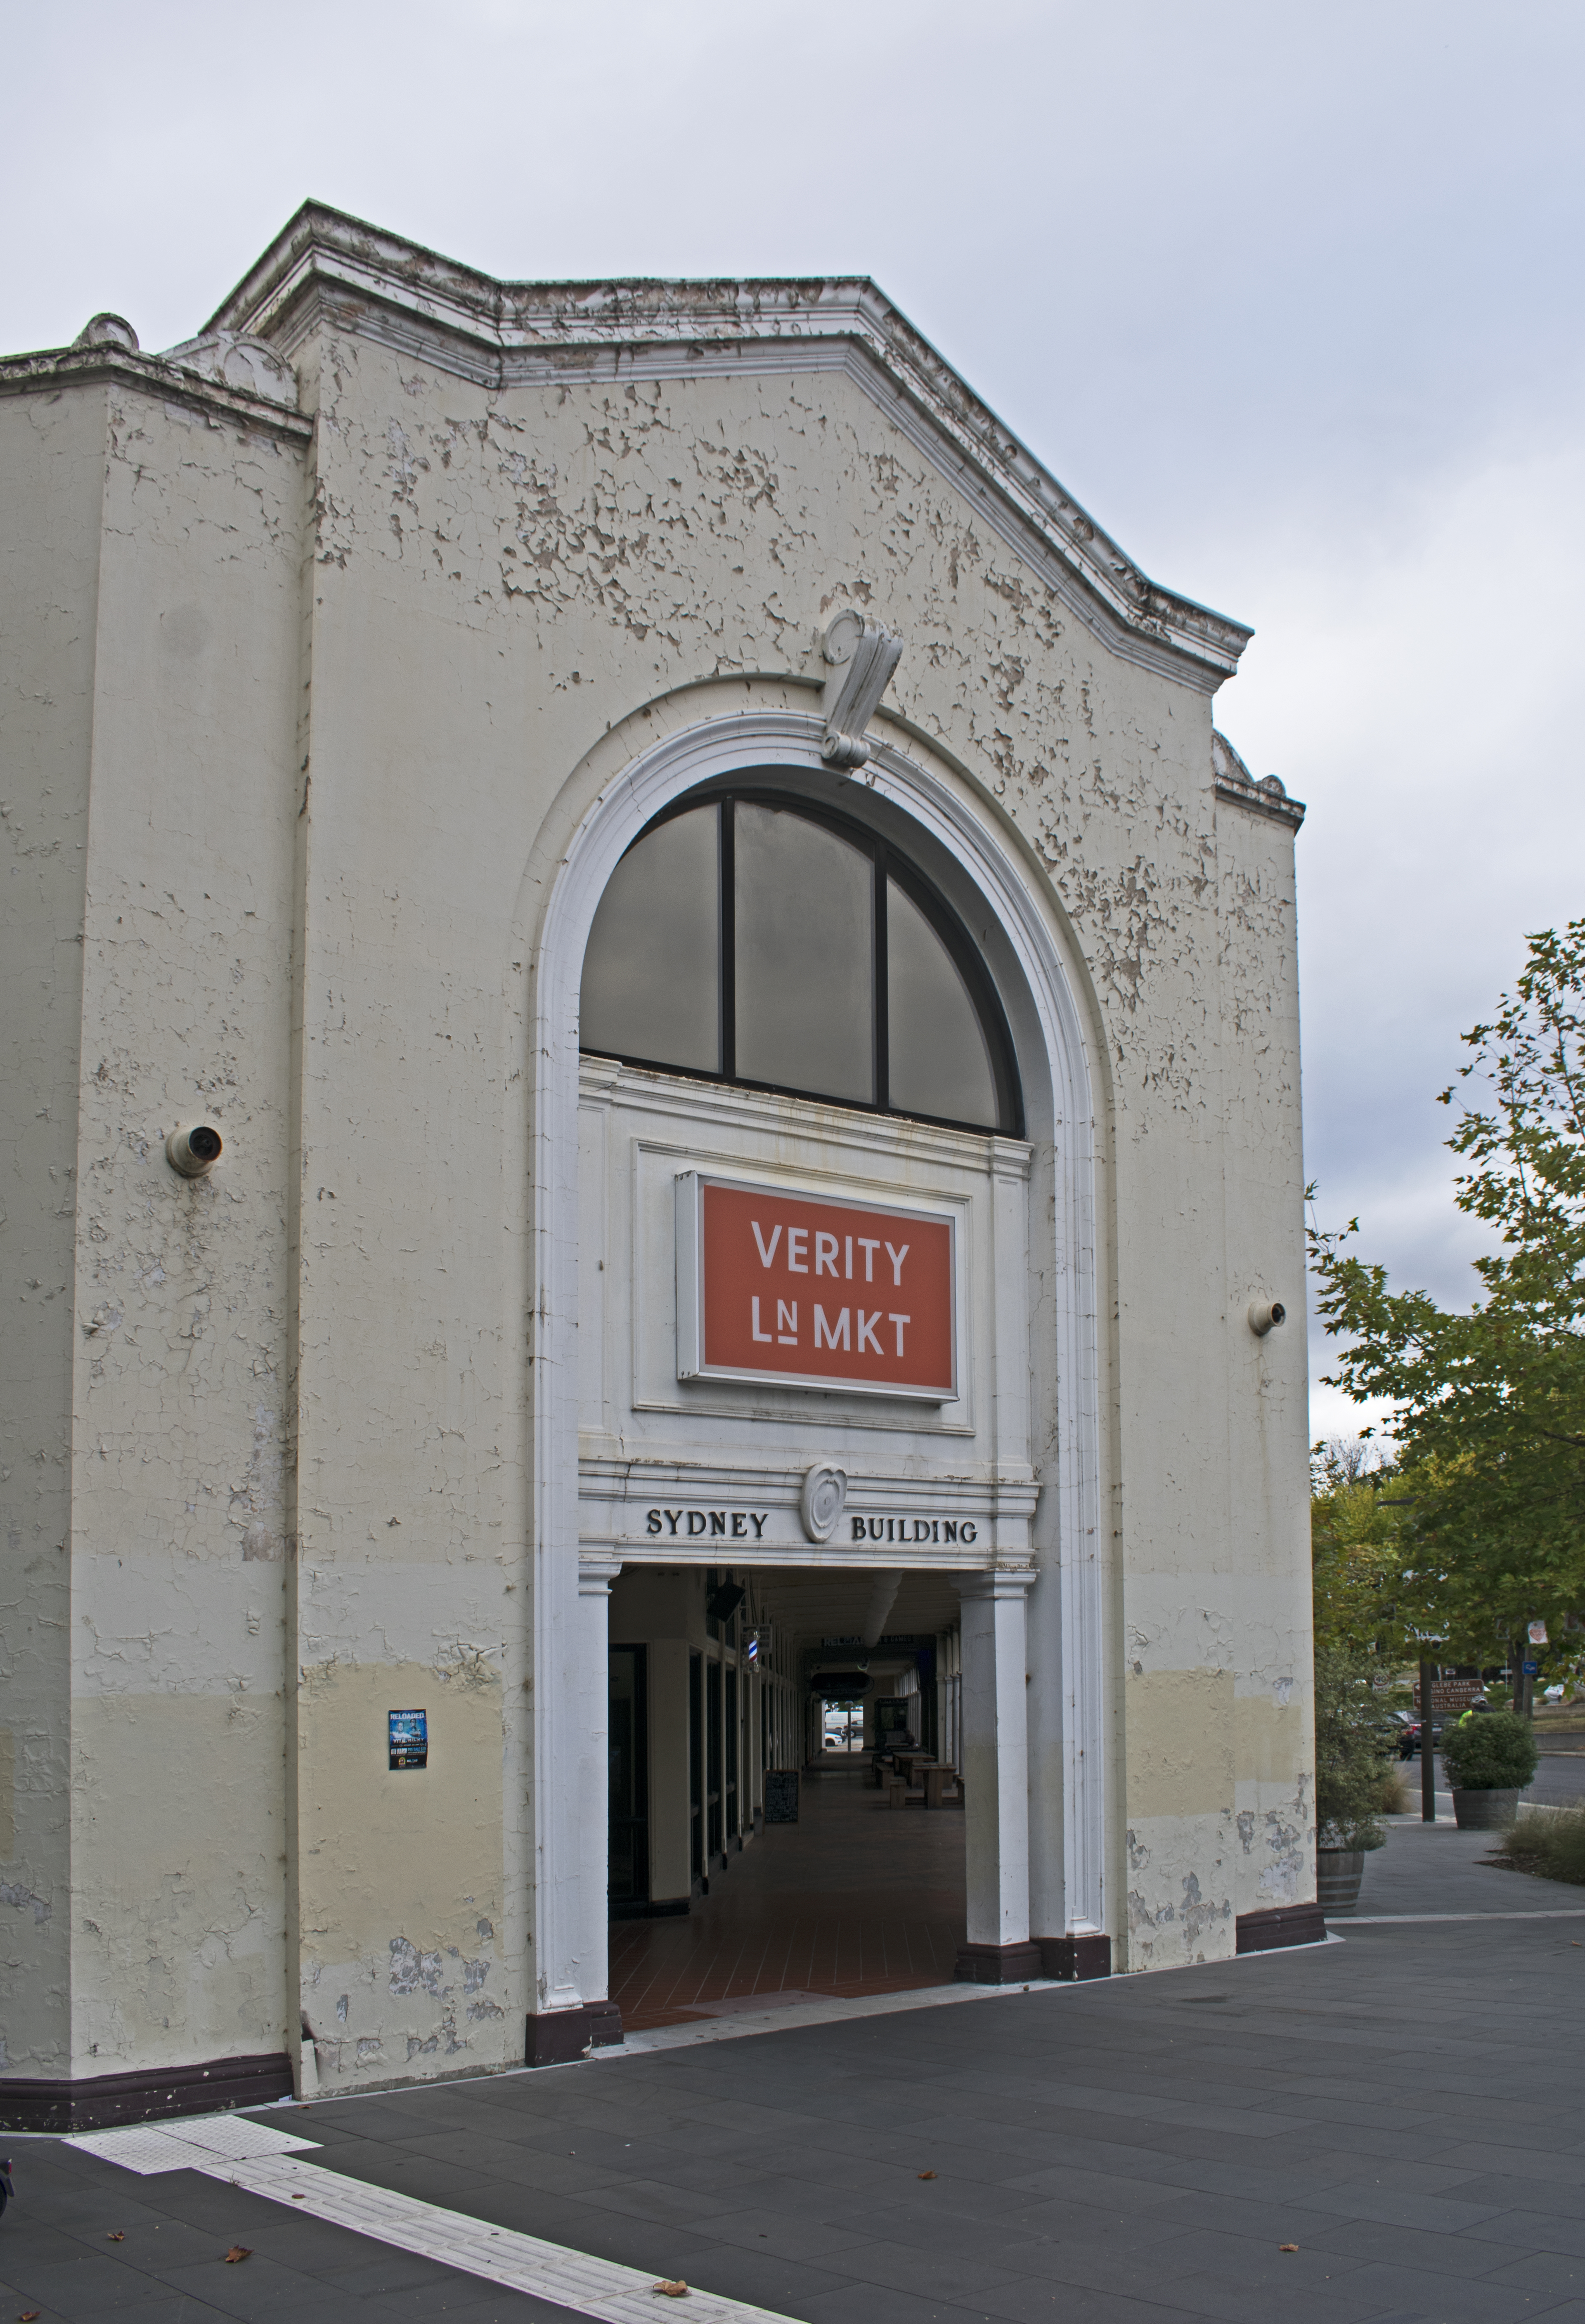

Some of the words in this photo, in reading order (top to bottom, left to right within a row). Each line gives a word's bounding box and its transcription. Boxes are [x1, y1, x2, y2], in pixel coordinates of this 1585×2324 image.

[750, 1220, 910, 1286] VERITY
[814, 1303, 911, 1357] MKT
[647, 1509, 769, 1538] SYDNEY
[852, 1516, 978, 1543] BUILDING
